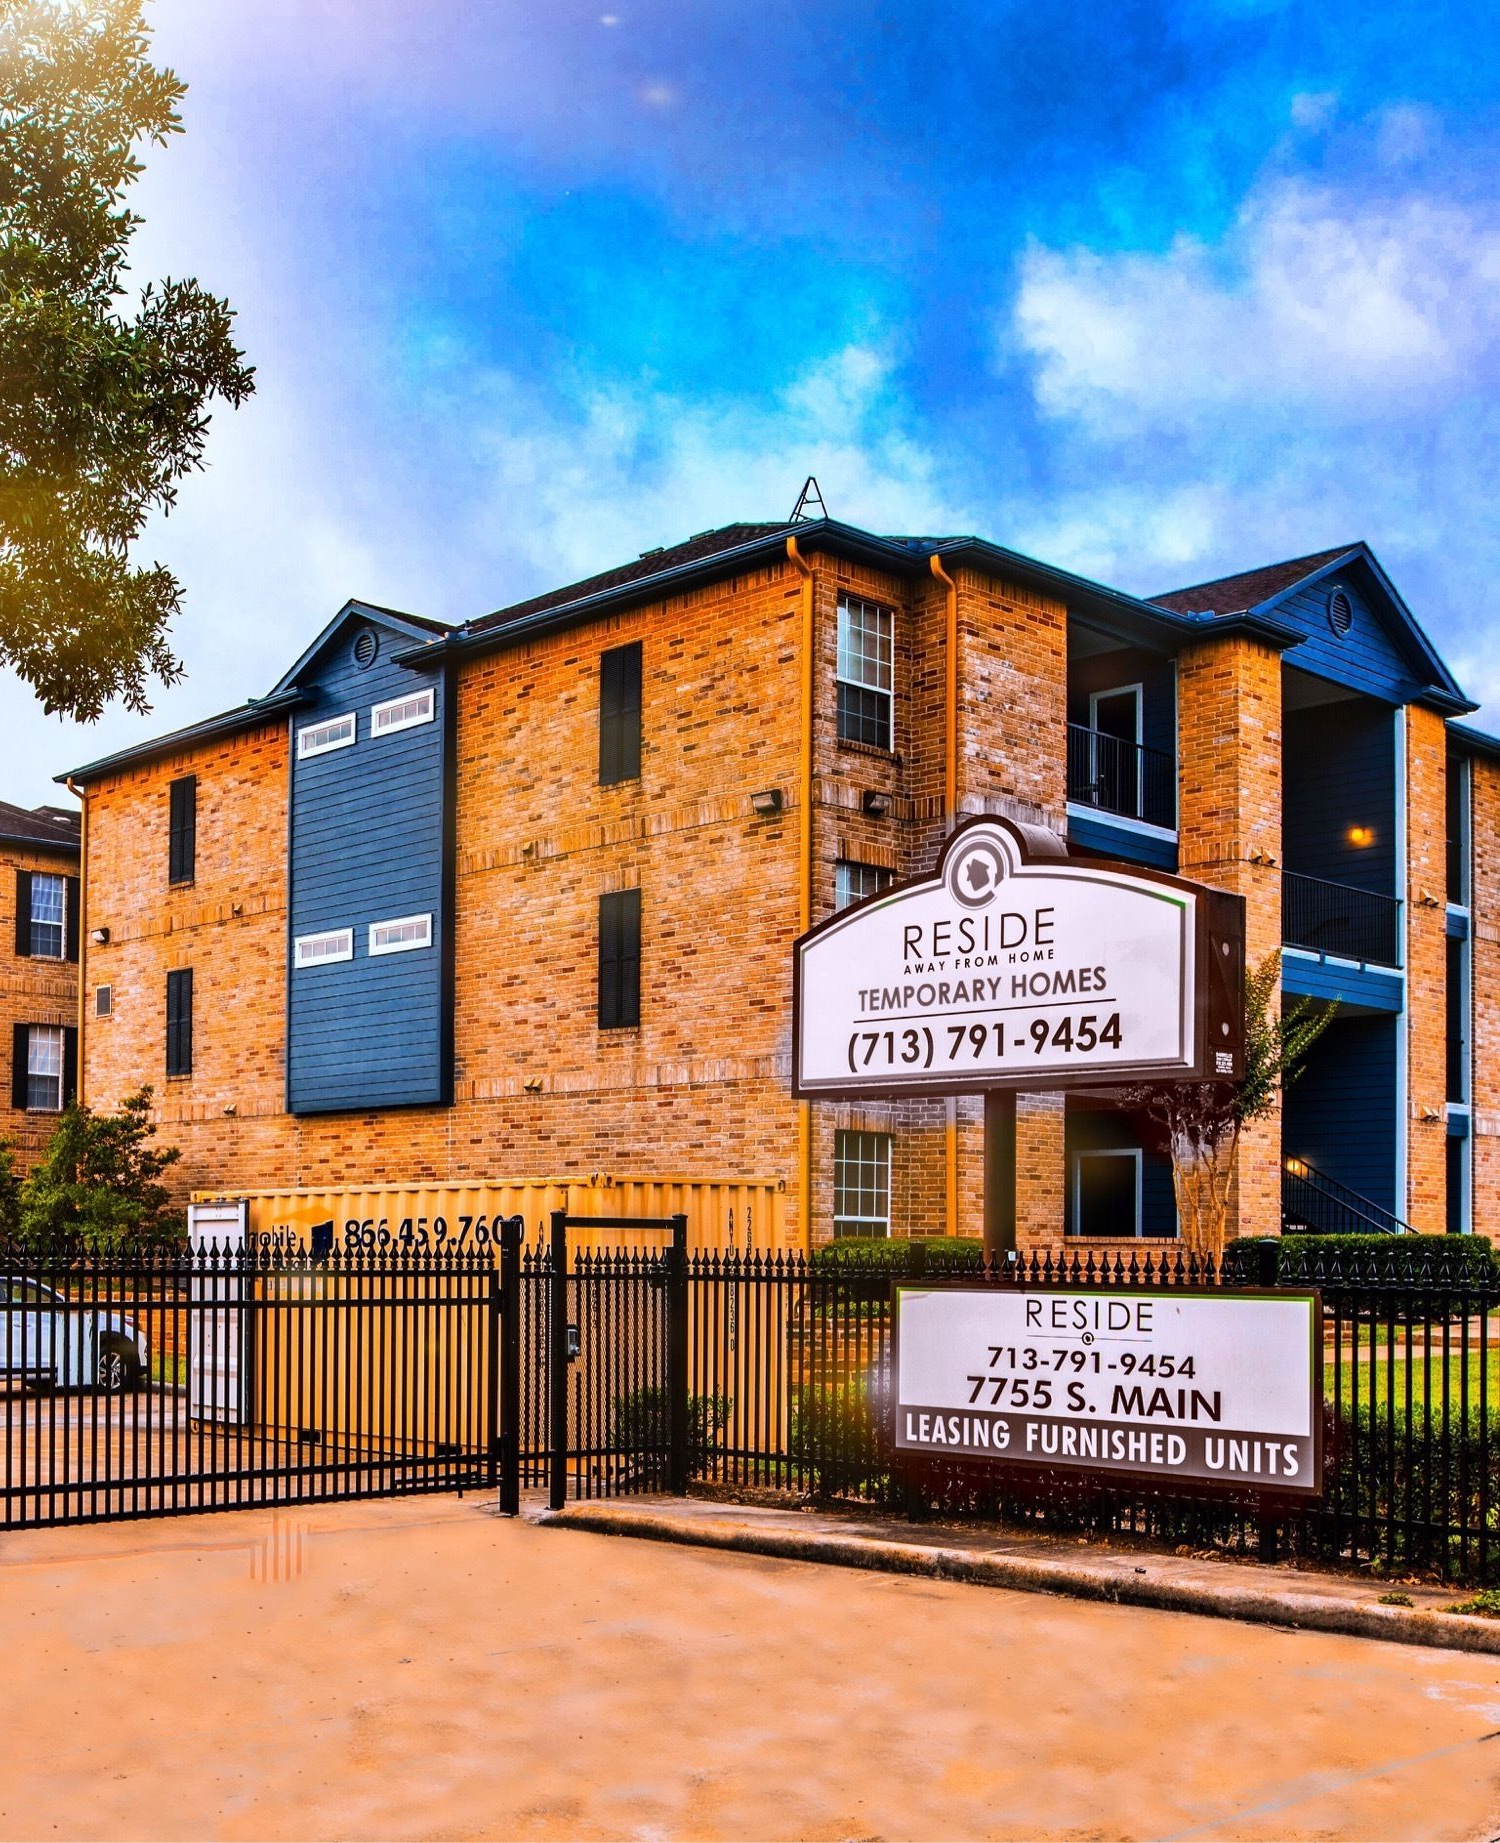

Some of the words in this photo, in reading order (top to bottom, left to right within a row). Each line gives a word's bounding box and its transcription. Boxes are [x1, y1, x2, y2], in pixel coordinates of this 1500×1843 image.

[904, 907, 1055, 960] RESIDE
[904, 960, 947, 975] AWAY
[955, 954, 998, 970] FROM
[1008, 948, 1055, 964] HOME
[858, 976, 1003, 1013] TEMPORARY
[1011, 966, 1108, 1000] HOMES
[848, 1027, 934, 1073] (713)
[947, 1013, 1123, 1061] 791-9454
[1026, 1300, 1154, 1332] RESIDE
[987, 1346, 1196, 1379] 713-791-9454
[966, 1375, 1053, 1409] 7755
[1067, 1381, 1097, 1413] S.
[1110, 1384, 1222, 1422] MAIN
[906, 1412, 1011, 1449] LEASING
[1026, 1423, 1187, 1466] FURNISHED
[1204, 1437, 1299, 1477] UNITS
